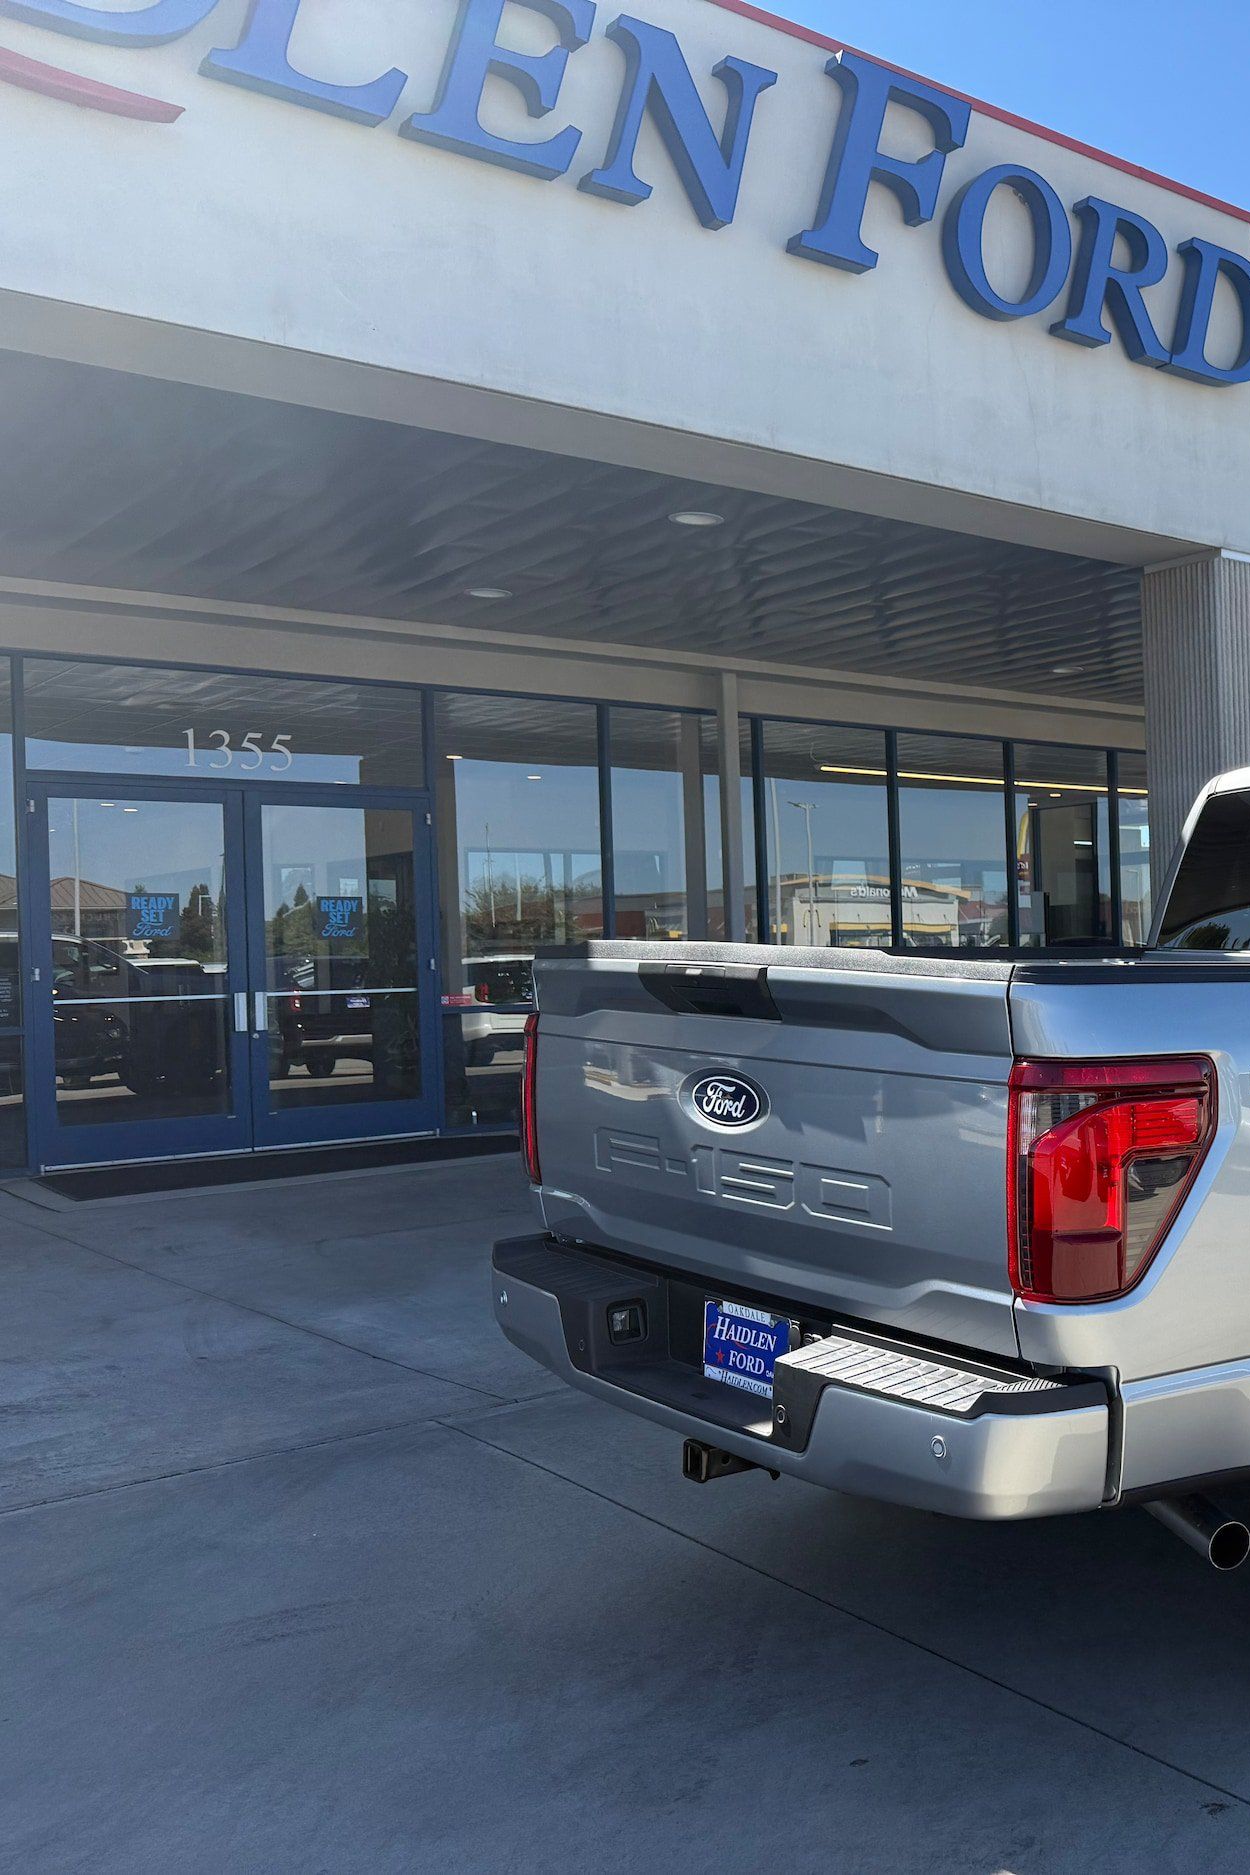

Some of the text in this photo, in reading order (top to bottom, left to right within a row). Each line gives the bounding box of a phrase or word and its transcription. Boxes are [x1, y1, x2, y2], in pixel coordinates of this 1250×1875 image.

[182, 728, 293, 771] 1355
[131, 896, 175, 910] READY
[320, 899, 359, 913] READY
[140, 909, 165, 924] SET
[329, 911, 350, 924] SET
[132, 921, 175, 938] Ford
[321, 923, 356, 938] Ford
[702, 1081, 747, 1119] Ford
[593, 1125, 894, 1231] F-150
[728, 1303, 766, 1322] OAKDALE
[713, 1316, 777, 1352] HAIDLEN
[728, 1350, 765, 1375] FORD
